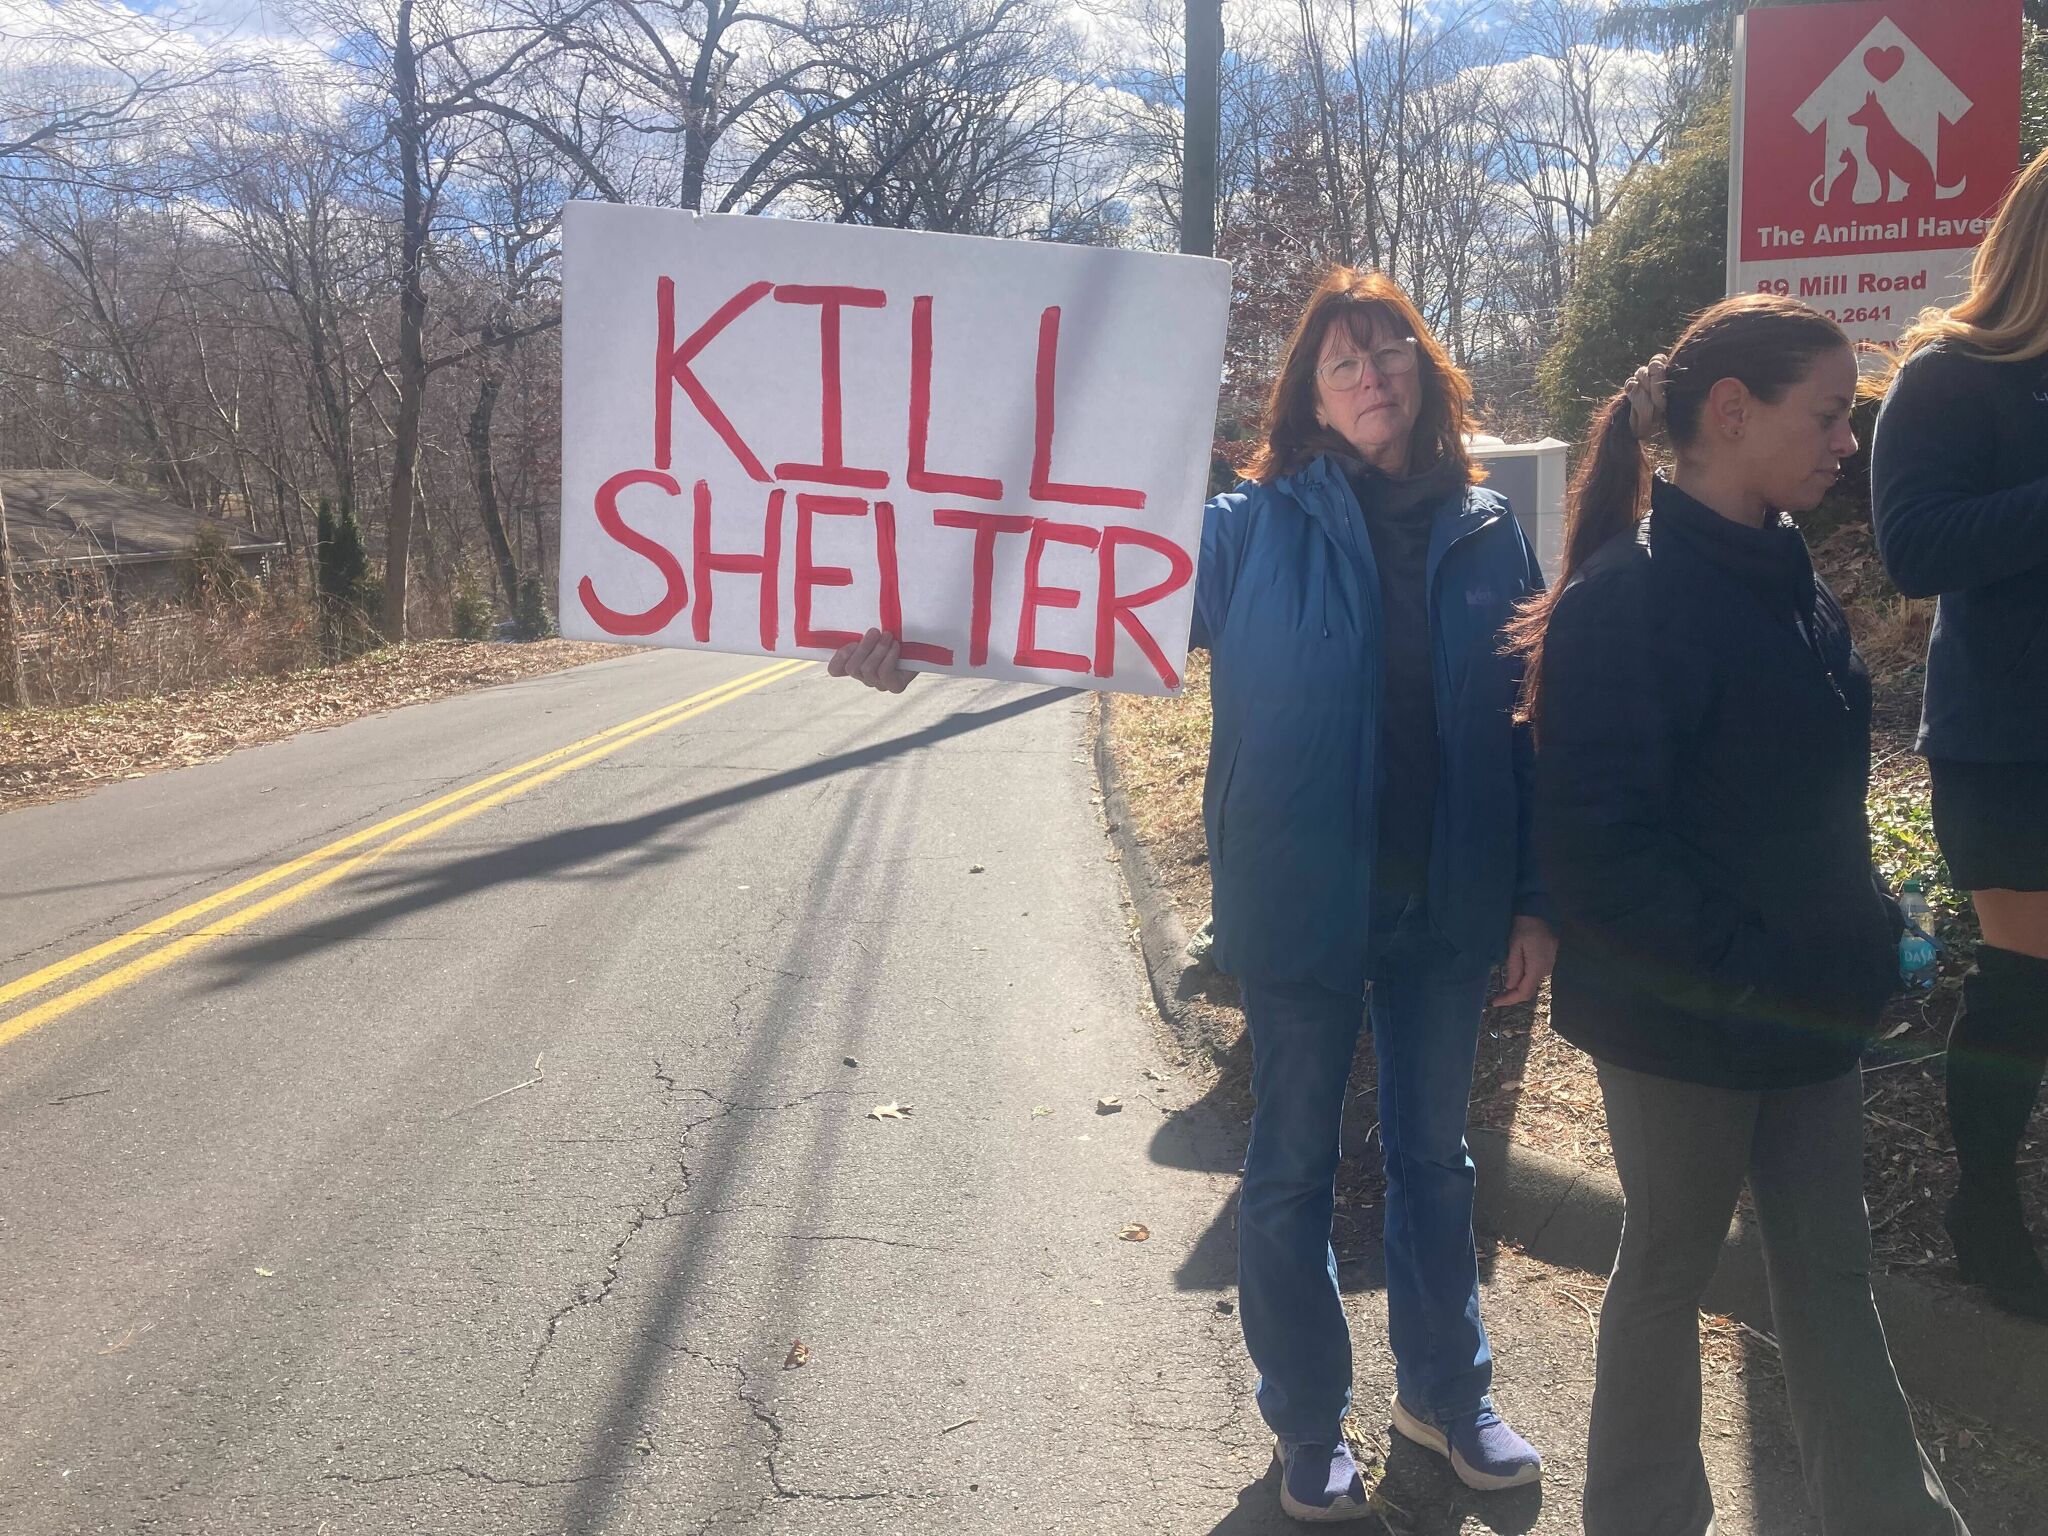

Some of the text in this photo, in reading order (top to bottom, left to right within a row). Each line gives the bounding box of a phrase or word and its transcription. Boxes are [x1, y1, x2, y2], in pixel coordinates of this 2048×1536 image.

[1757, 225, 1805, 248] The
[1813, 217, 1908, 245] Animal
[1757, 270, 1927, 297] 89 Mill Road
[654, 275, 1147, 509] KILL
[577, 469, 1194, 690] SHELTER
